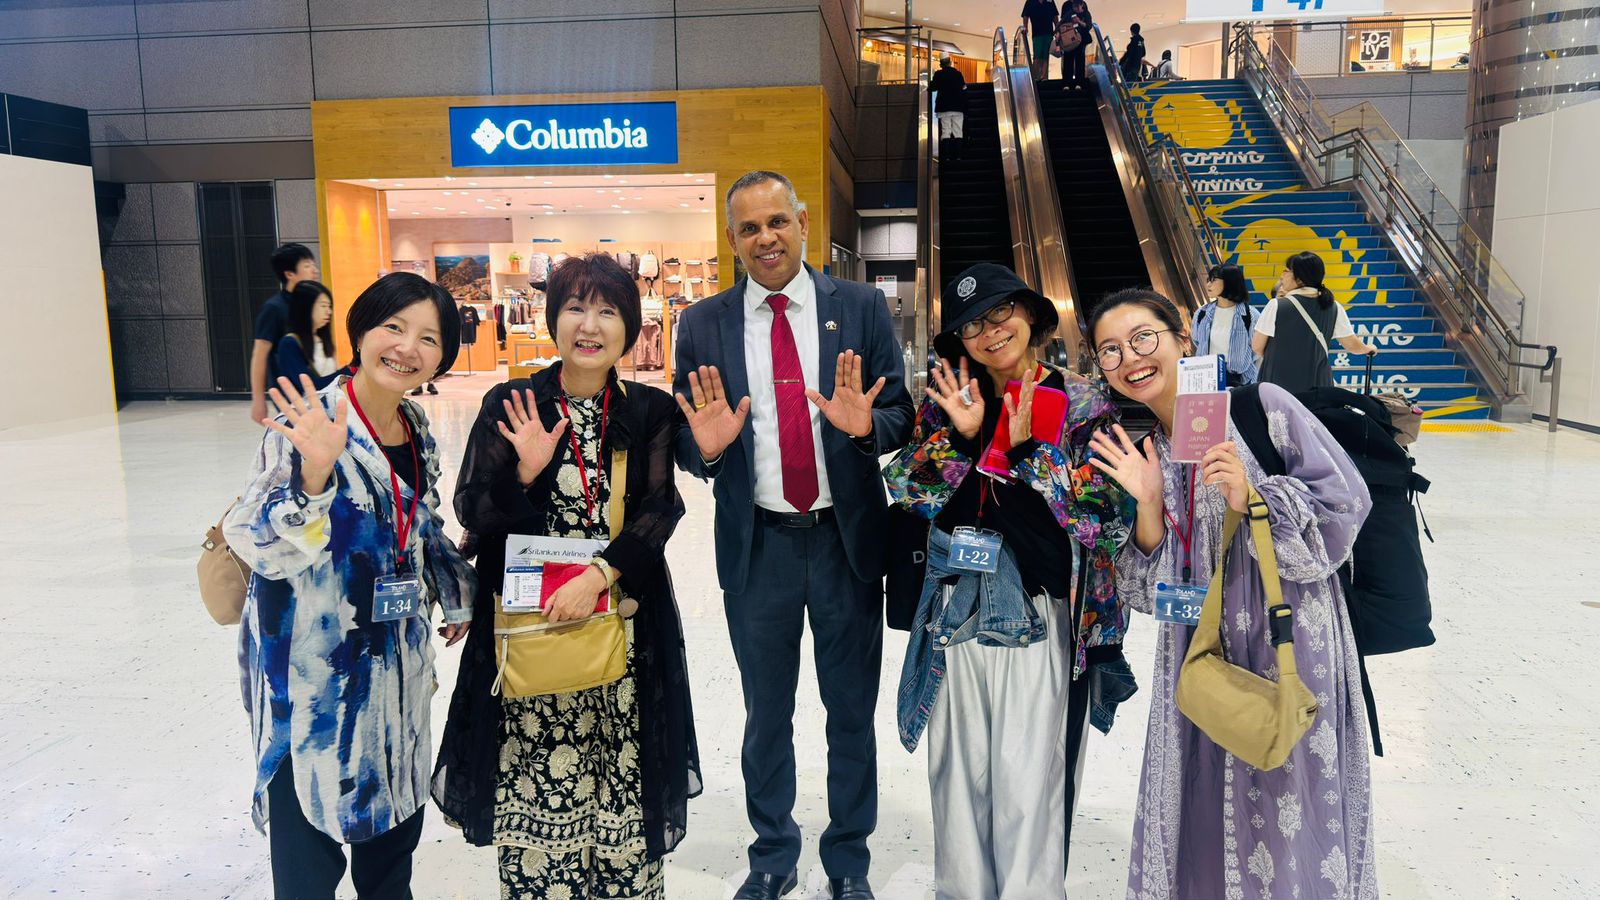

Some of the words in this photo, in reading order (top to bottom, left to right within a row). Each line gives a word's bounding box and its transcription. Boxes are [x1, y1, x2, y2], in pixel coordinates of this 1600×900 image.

[505, 118, 648, 150] Columbia
[1208, 165, 1219, 175] &
[1334, 352, 1350, 367] &
[1188, 435, 1210, 443] JAPAN
[527, 547, 560, 556] SriLankan
[561, 549, 587, 558] Airlines
[957, 548, 990, 566] 1-22
[381, 598, 412, 615] 1-34
[1163, 602, 1202, 619] 1-32
